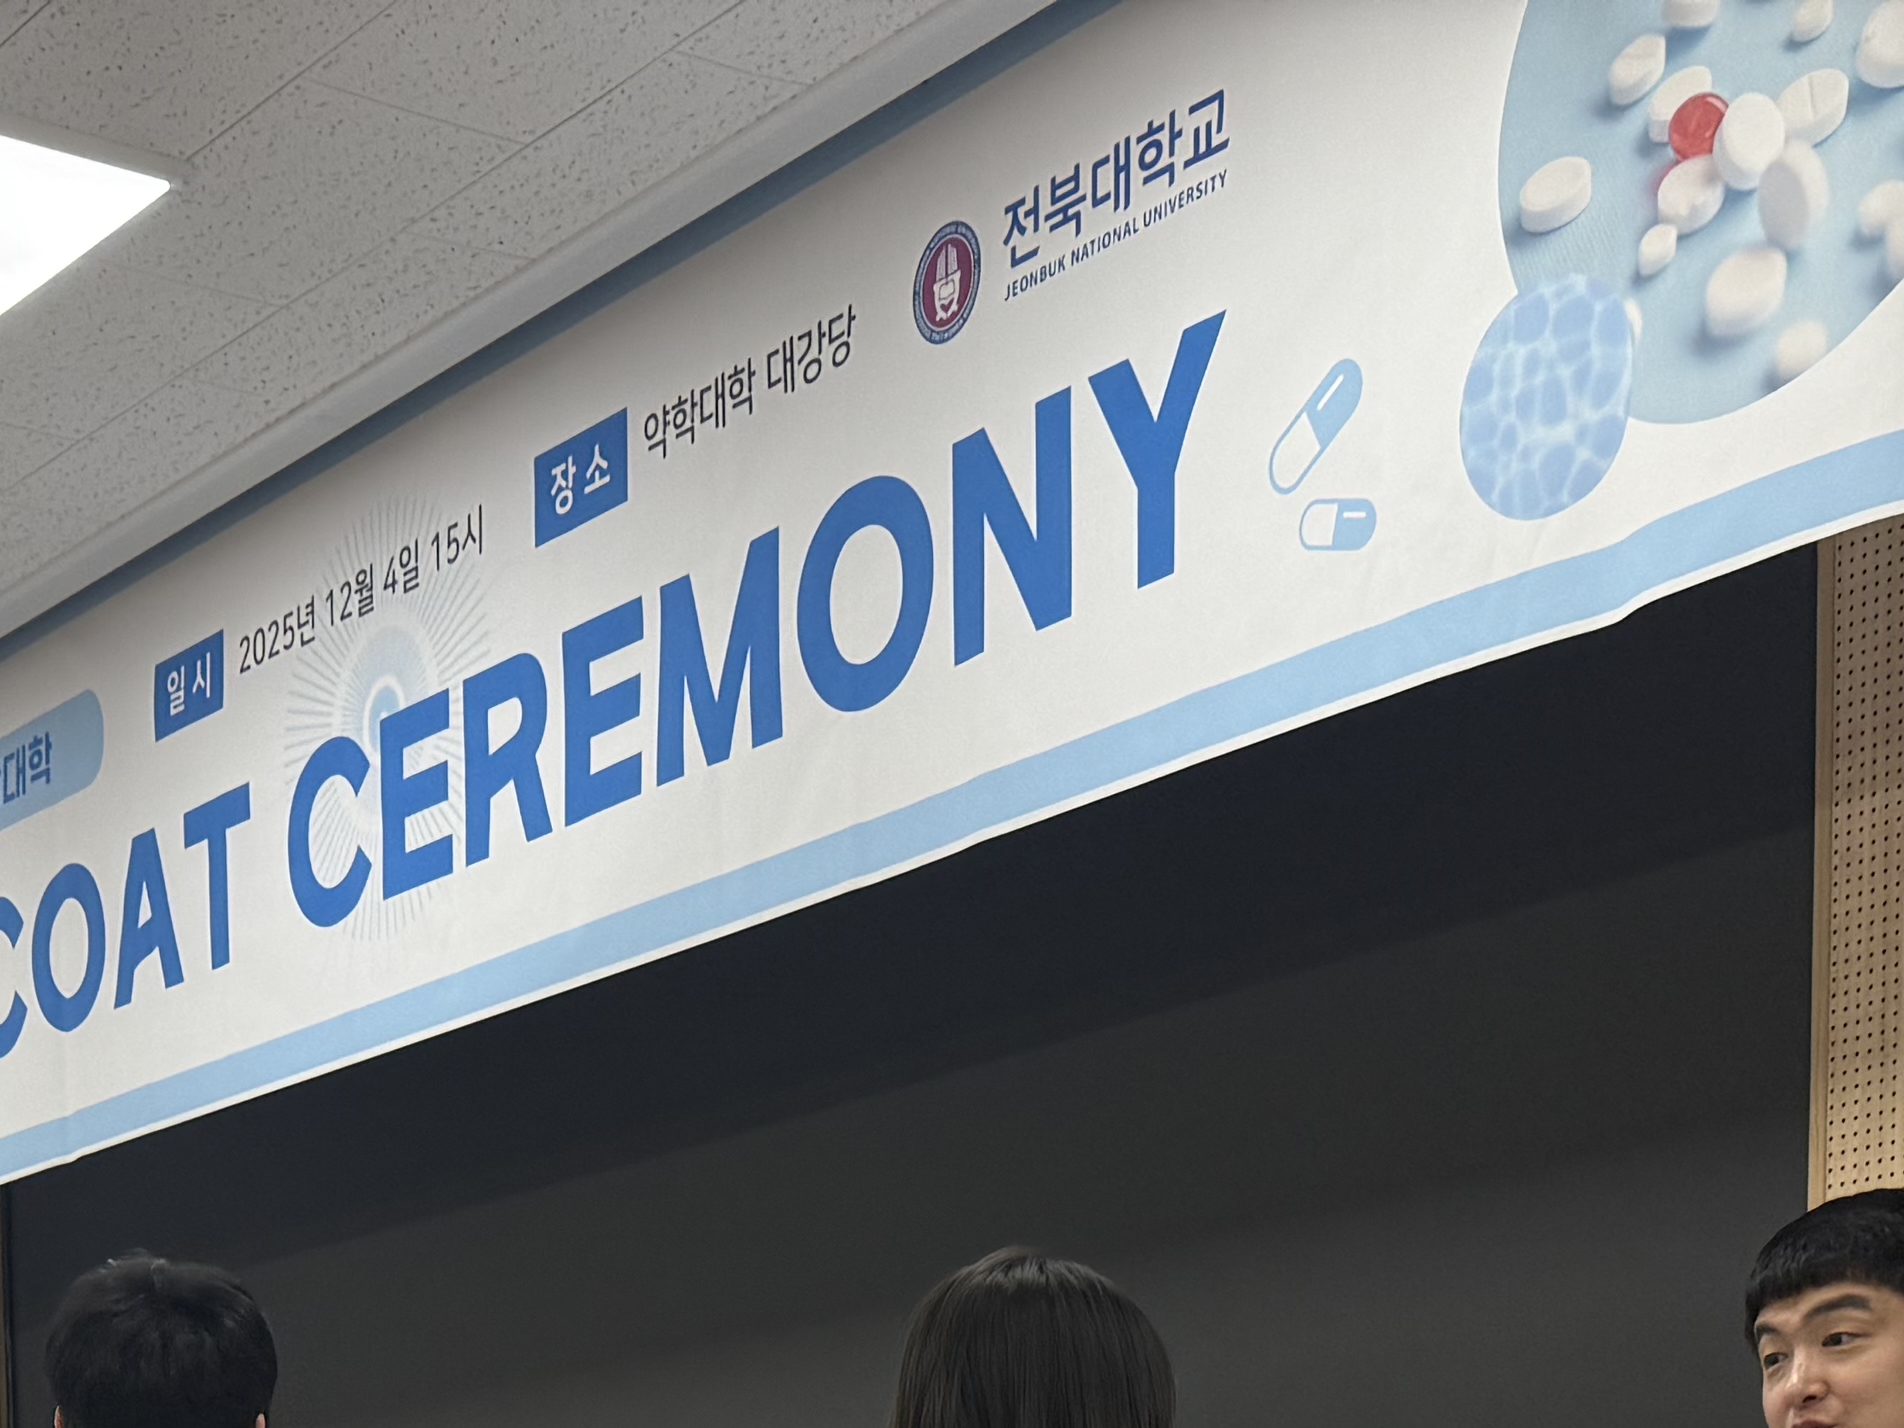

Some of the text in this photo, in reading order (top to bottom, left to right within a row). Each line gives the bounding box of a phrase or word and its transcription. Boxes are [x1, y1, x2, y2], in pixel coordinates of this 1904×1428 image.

[1002, 88, 1231, 270] 전북대학교
[1003, 168, 1228, 302] JEONBUK NATIONAL UNIVERSITY
[549, 303, 857, 515] 장소 약학대학 대강당
[166, 503, 483, 717] 일시 2025년 12월 4일 15시
[287, 309, 1228, 928] CEREMONY
